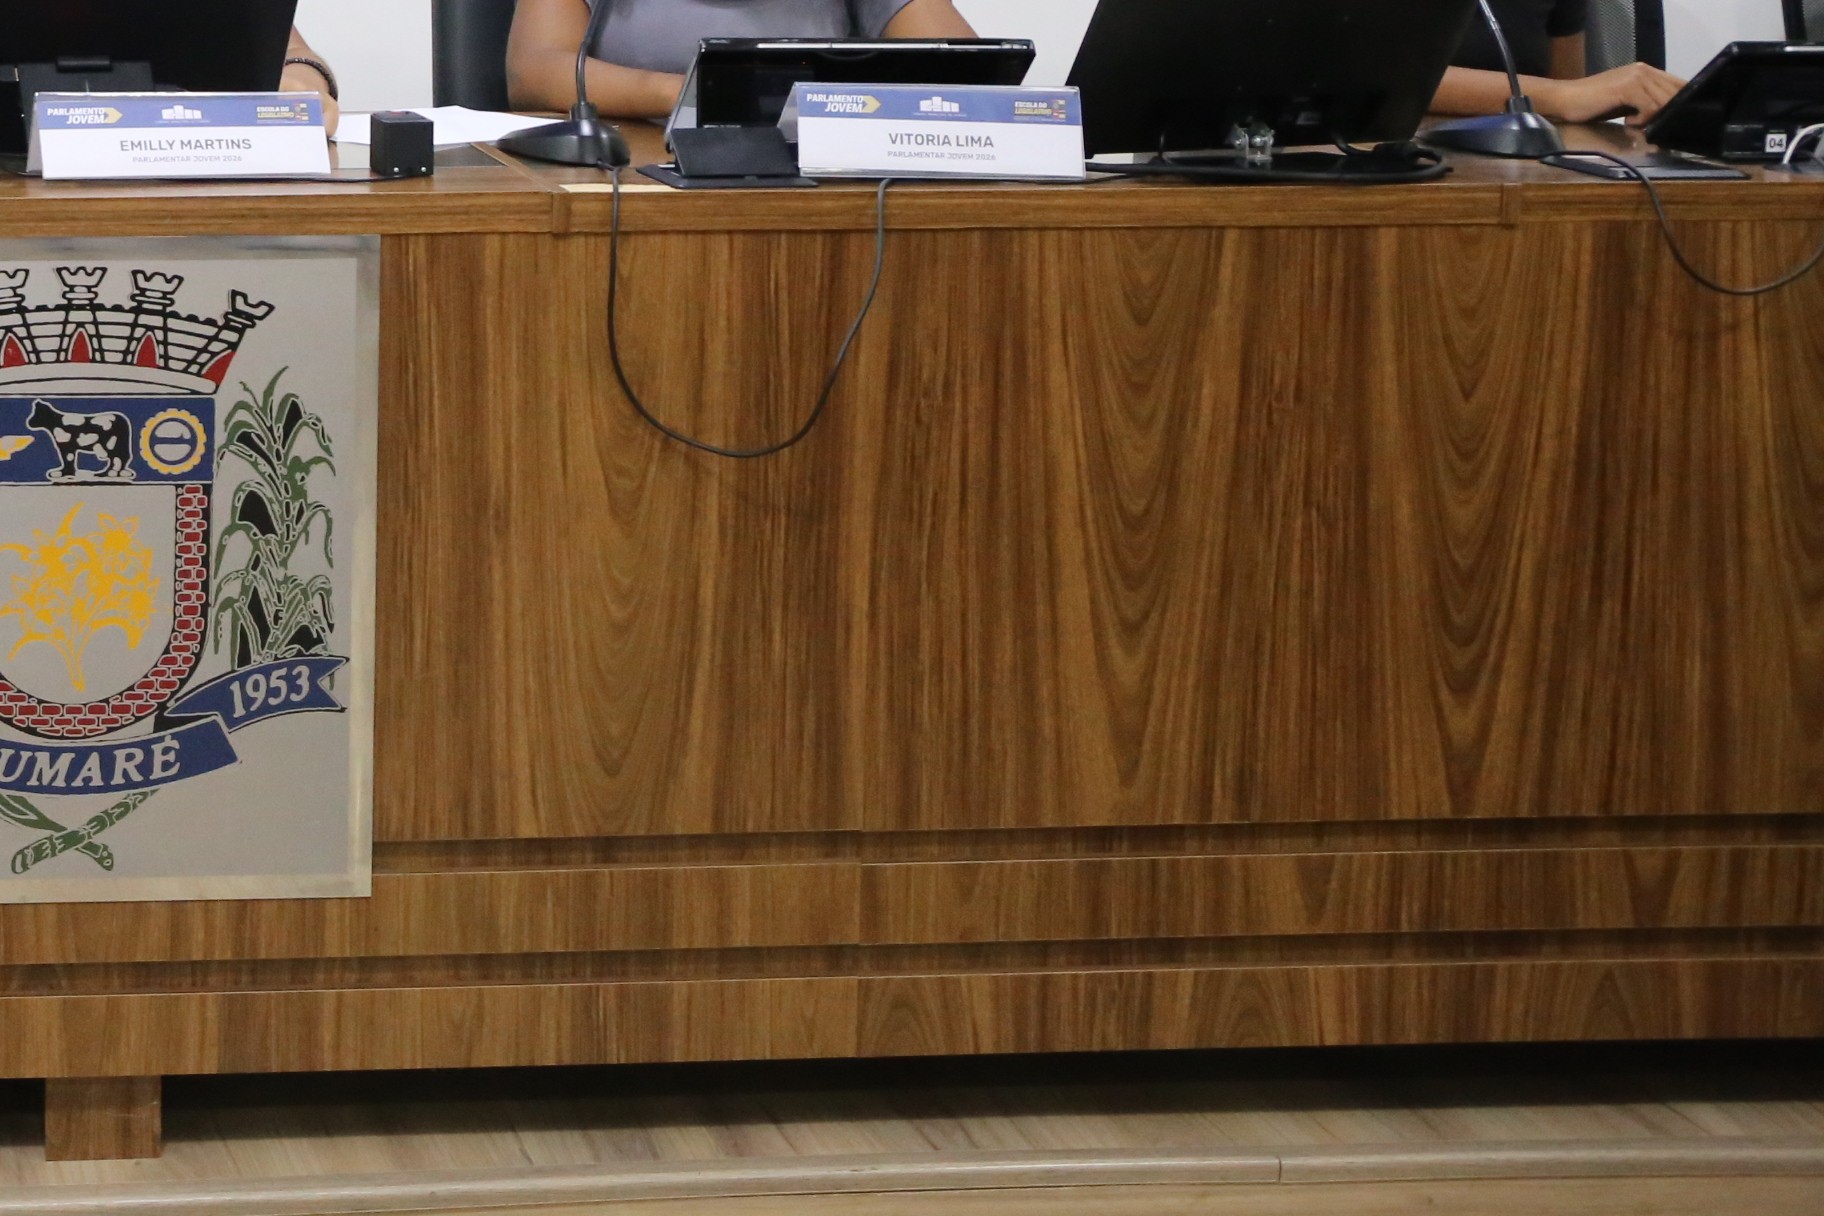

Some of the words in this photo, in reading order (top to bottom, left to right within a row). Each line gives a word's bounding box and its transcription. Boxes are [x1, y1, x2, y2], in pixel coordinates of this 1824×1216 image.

[807, 93, 863, 103] PARLAMENTO
[47, 107, 104, 116] PARLAMENTO
[825, 102, 863, 113] JOVEM
[66, 115, 105, 124] JOVEM
[120, 140, 176, 152] EMILLY
[180, 139, 252, 150] MARTINS
[889, 133, 952, 147] VITORIA
[956, 135, 994, 148] LIMA
[1769, 137, 1785, 149] 04
[888, 151, 945, 159] PARLAMENTAR
[947, 152, 974, 160] JOVEM
[229, 664, 312, 714] 1953
